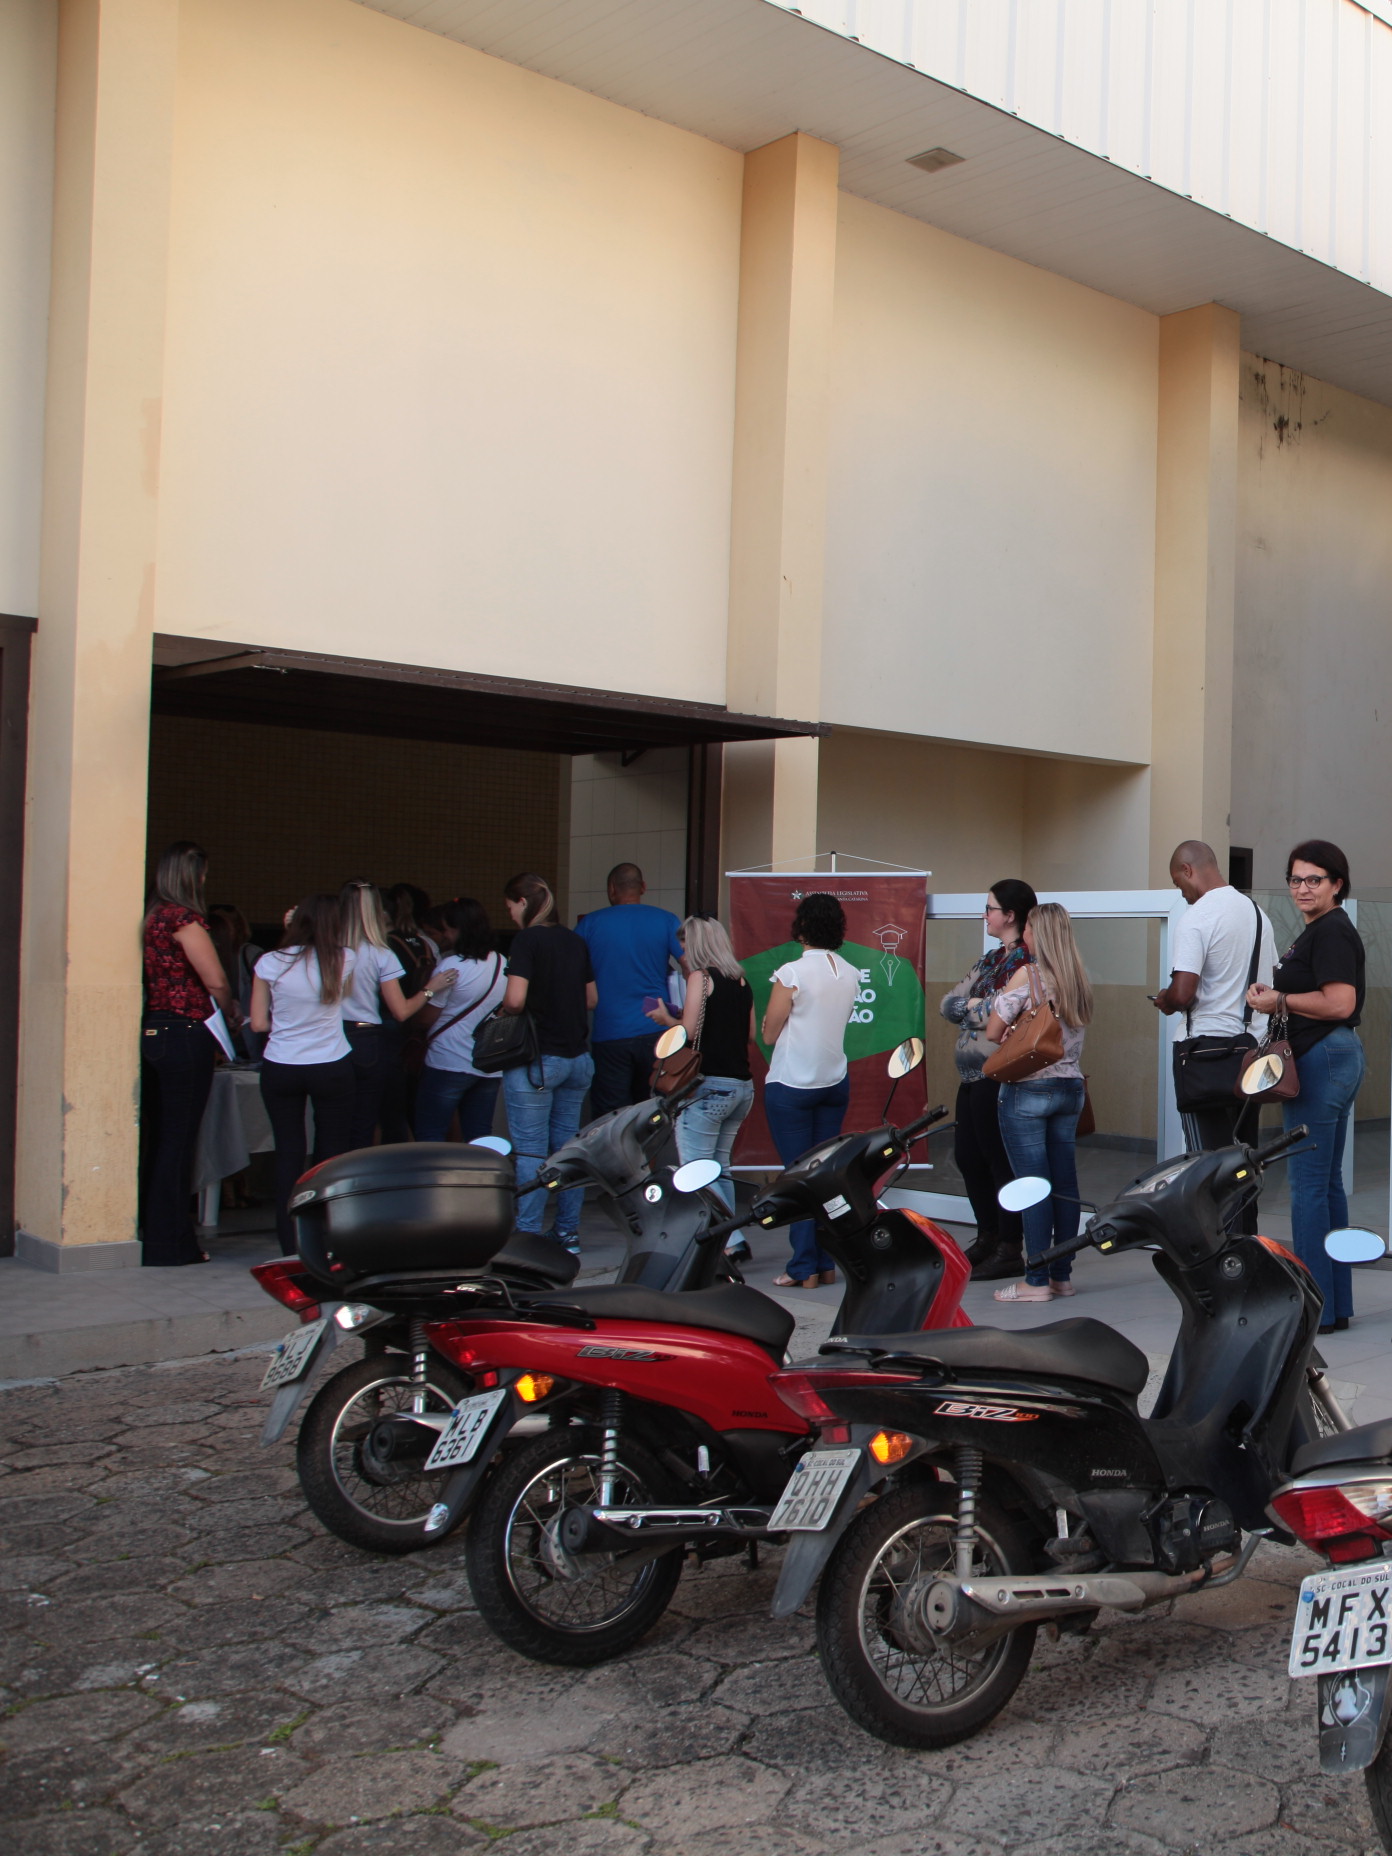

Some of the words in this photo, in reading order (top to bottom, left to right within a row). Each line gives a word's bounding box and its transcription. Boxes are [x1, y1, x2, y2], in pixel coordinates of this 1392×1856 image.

[445, 1408, 489, 1439] MLB
[731, 1410, 769, 1419] HONDA
[430, 1434, 475, 1465] 6361
[790, 1469, 844, 1497] QHH
[1091, 1469, 1127, 1477] HONDA
[774, 1498, 830, 1526] 7610
[1203, 1519, 1230, 1532] HONDA
[1361, 1576, 1371, 1584] DO
[1374, 1573, 1390, 1583] SUL
[1308, 1586, 1390, 1631] MFX
[1300, 1622, 1388, 1668] 5413
